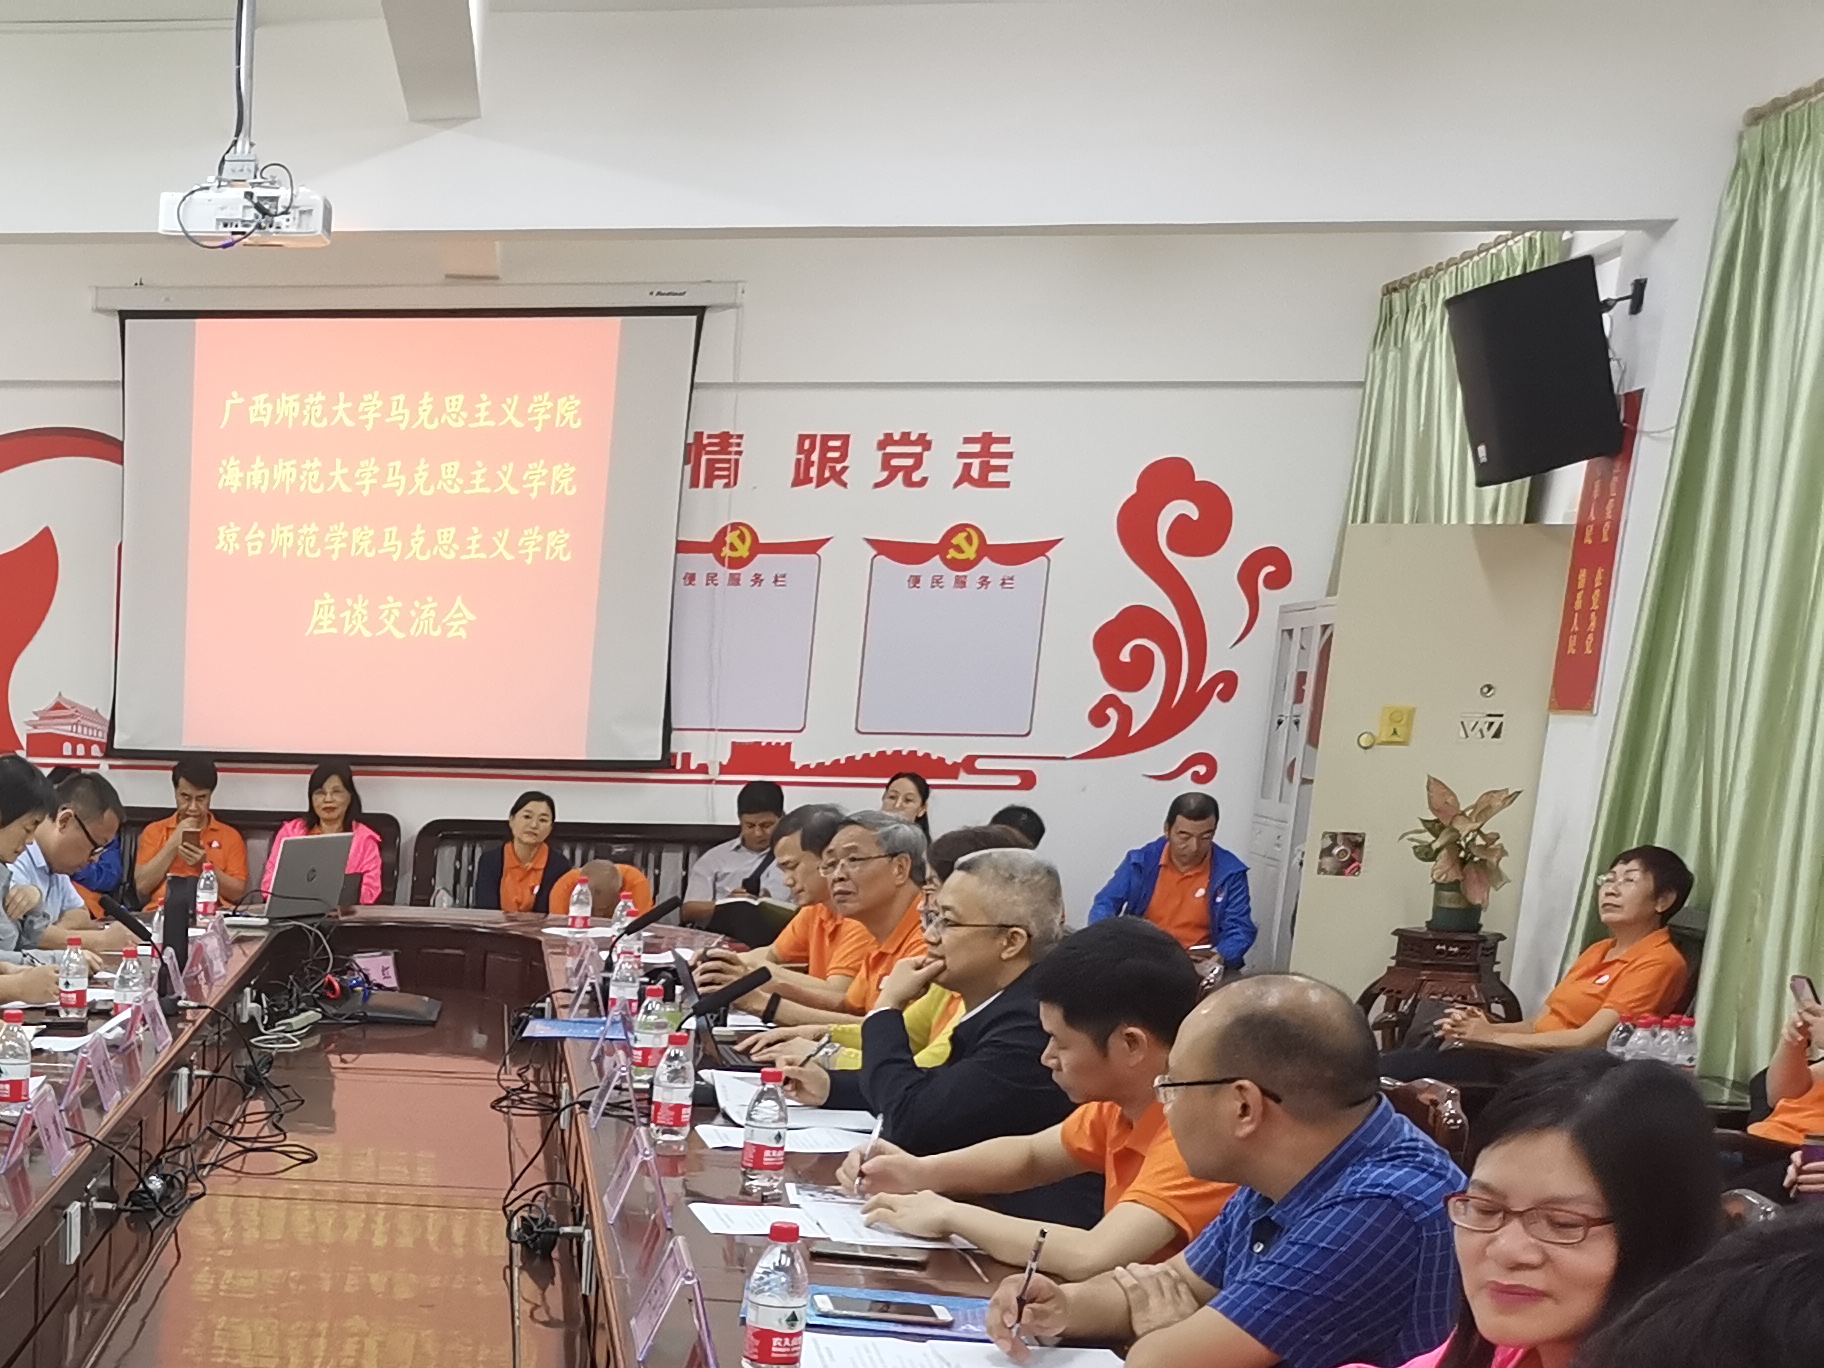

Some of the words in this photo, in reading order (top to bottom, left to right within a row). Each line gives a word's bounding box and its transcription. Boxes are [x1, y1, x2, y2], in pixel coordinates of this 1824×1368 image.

[220, 391, 582, 431] 广西师范大学马克思主义学院
[217, 456, 577, 499] 海南师范大学马克思主义学院
[791, 431, 1014, 490] 跟党走
[214, 521, 572, 564] 琼台师范学院马克思主义学院
[683, 572, 788, 588] 便民服务栏
[907, 574, 1015, 590] 便民服务栏
[305, 593, 477, 639] 座谈交流会
